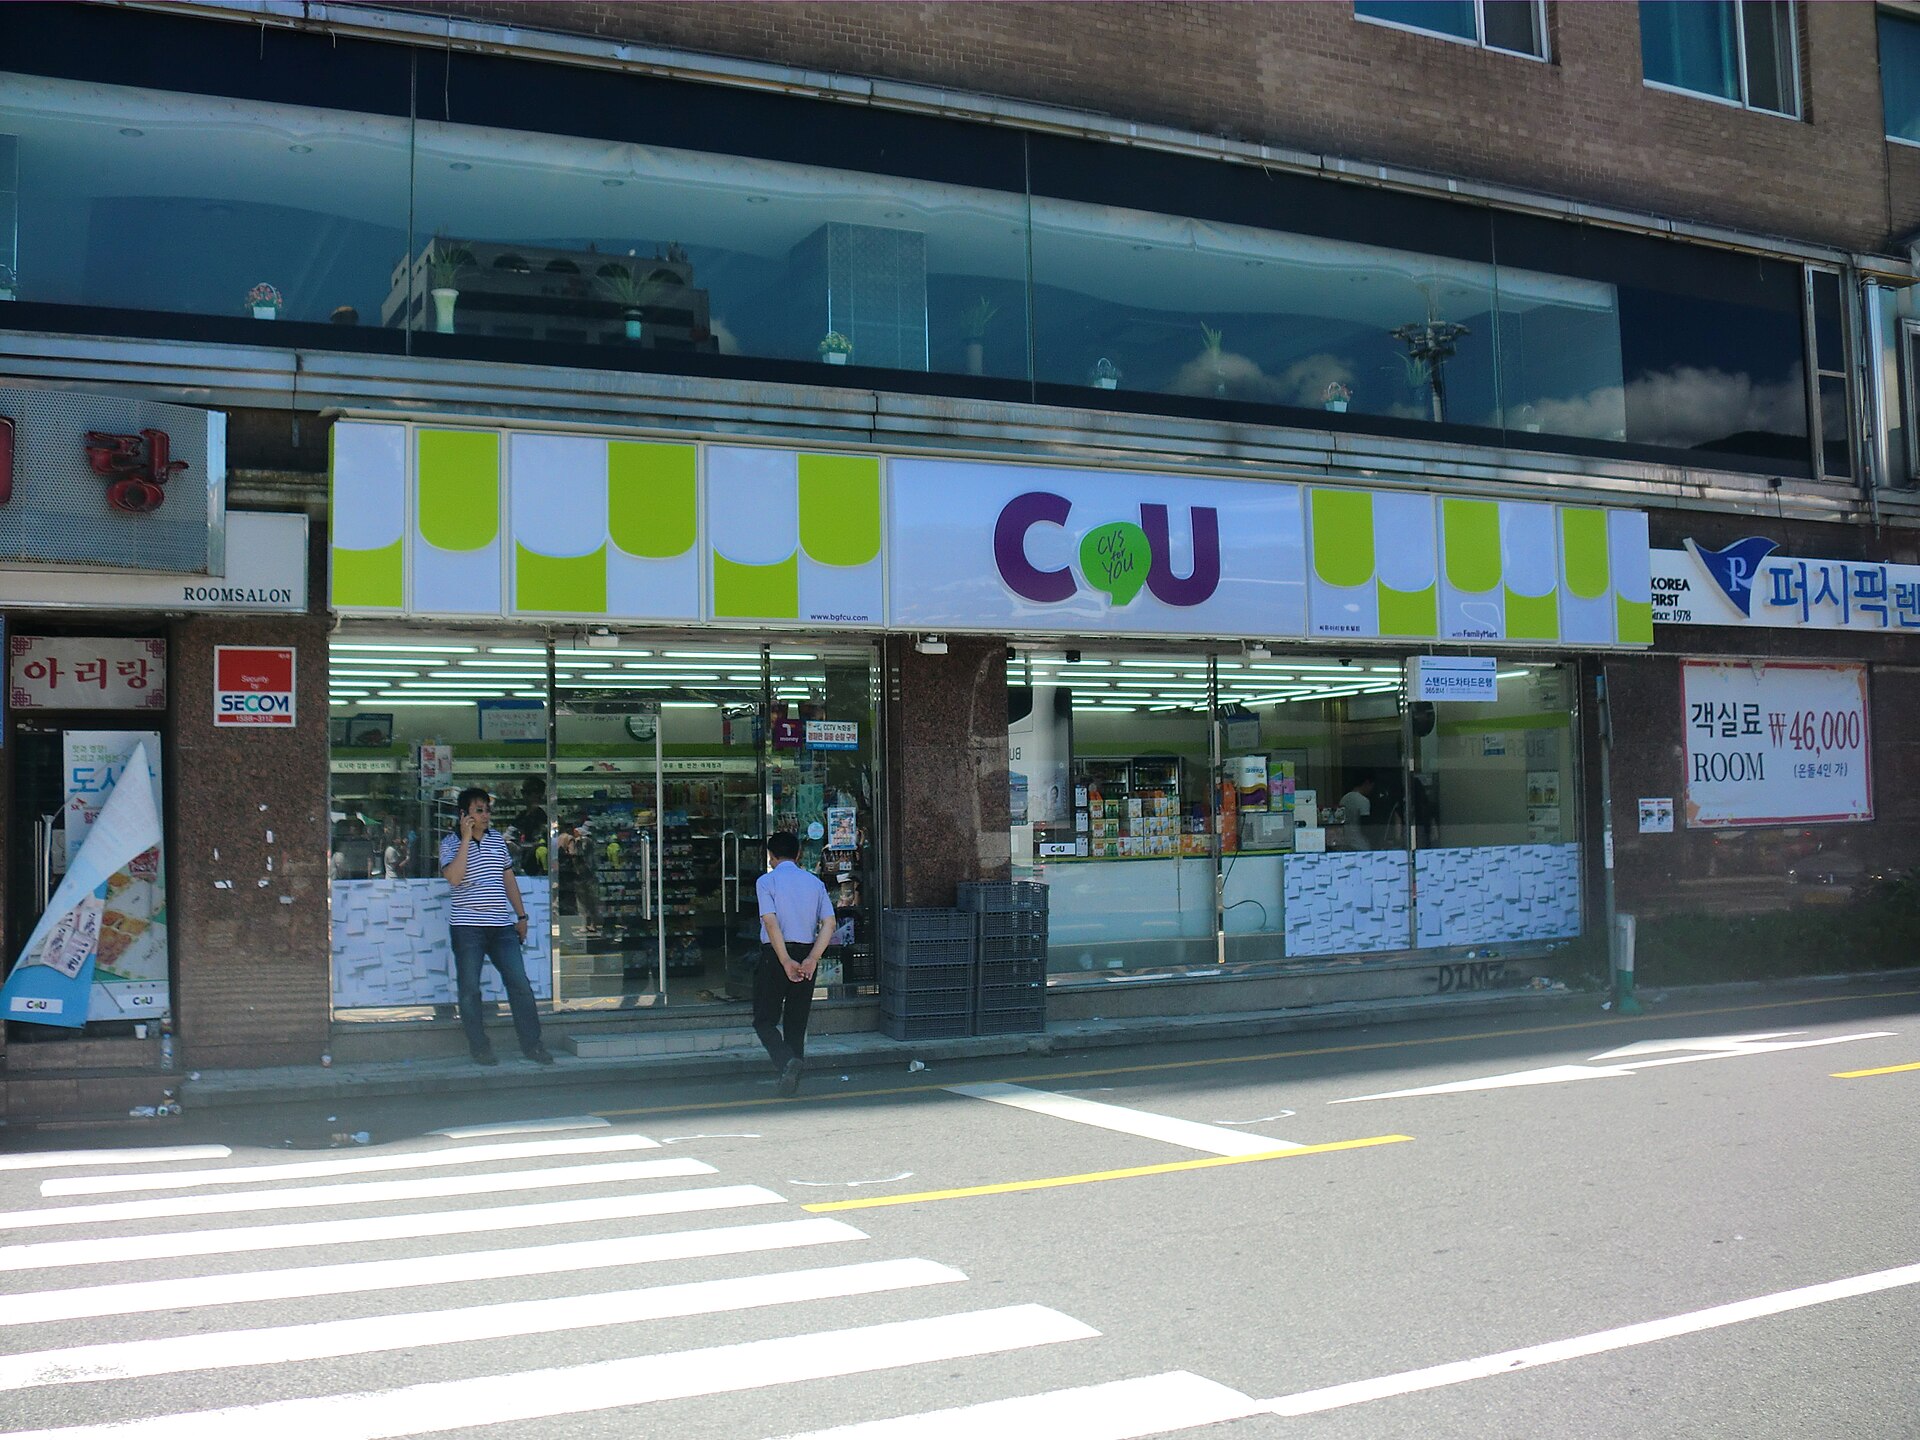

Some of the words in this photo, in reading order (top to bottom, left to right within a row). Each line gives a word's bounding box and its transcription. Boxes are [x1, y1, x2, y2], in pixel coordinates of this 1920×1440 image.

[1097, 529, 1125, 555] CVS
[1101, 552, 1134, 585] YOU
[1650, 577, 1691, 591] KOREA
[183, 586, 291, 603] ROOMSALON
[1651, 593, 1679, 606] FIRST
[1769, 561, 1888, 628] 퍼시픽
[810, 613, 869, 622] www.bgfcu.com
[1672, 609, 1692, 622] 1978
[1463, 629, 1498, 640] FamilyMart
[23, 656, 154, 691] 아리랑
[1424, 676, 1493, 688] 스탠다드차타드은행
[221, 694, 290, 713] SECOM
[1691, 702, 1763, 738] 객실료
[1767, 710, 1861, 758] ₩46,000
[1693, 752, 1765, 782] ROOM
[1051, 845, 1065, 854] CU
[26, 1000, 48, 1010] CU
[132, 996, 153, 1006] CU
